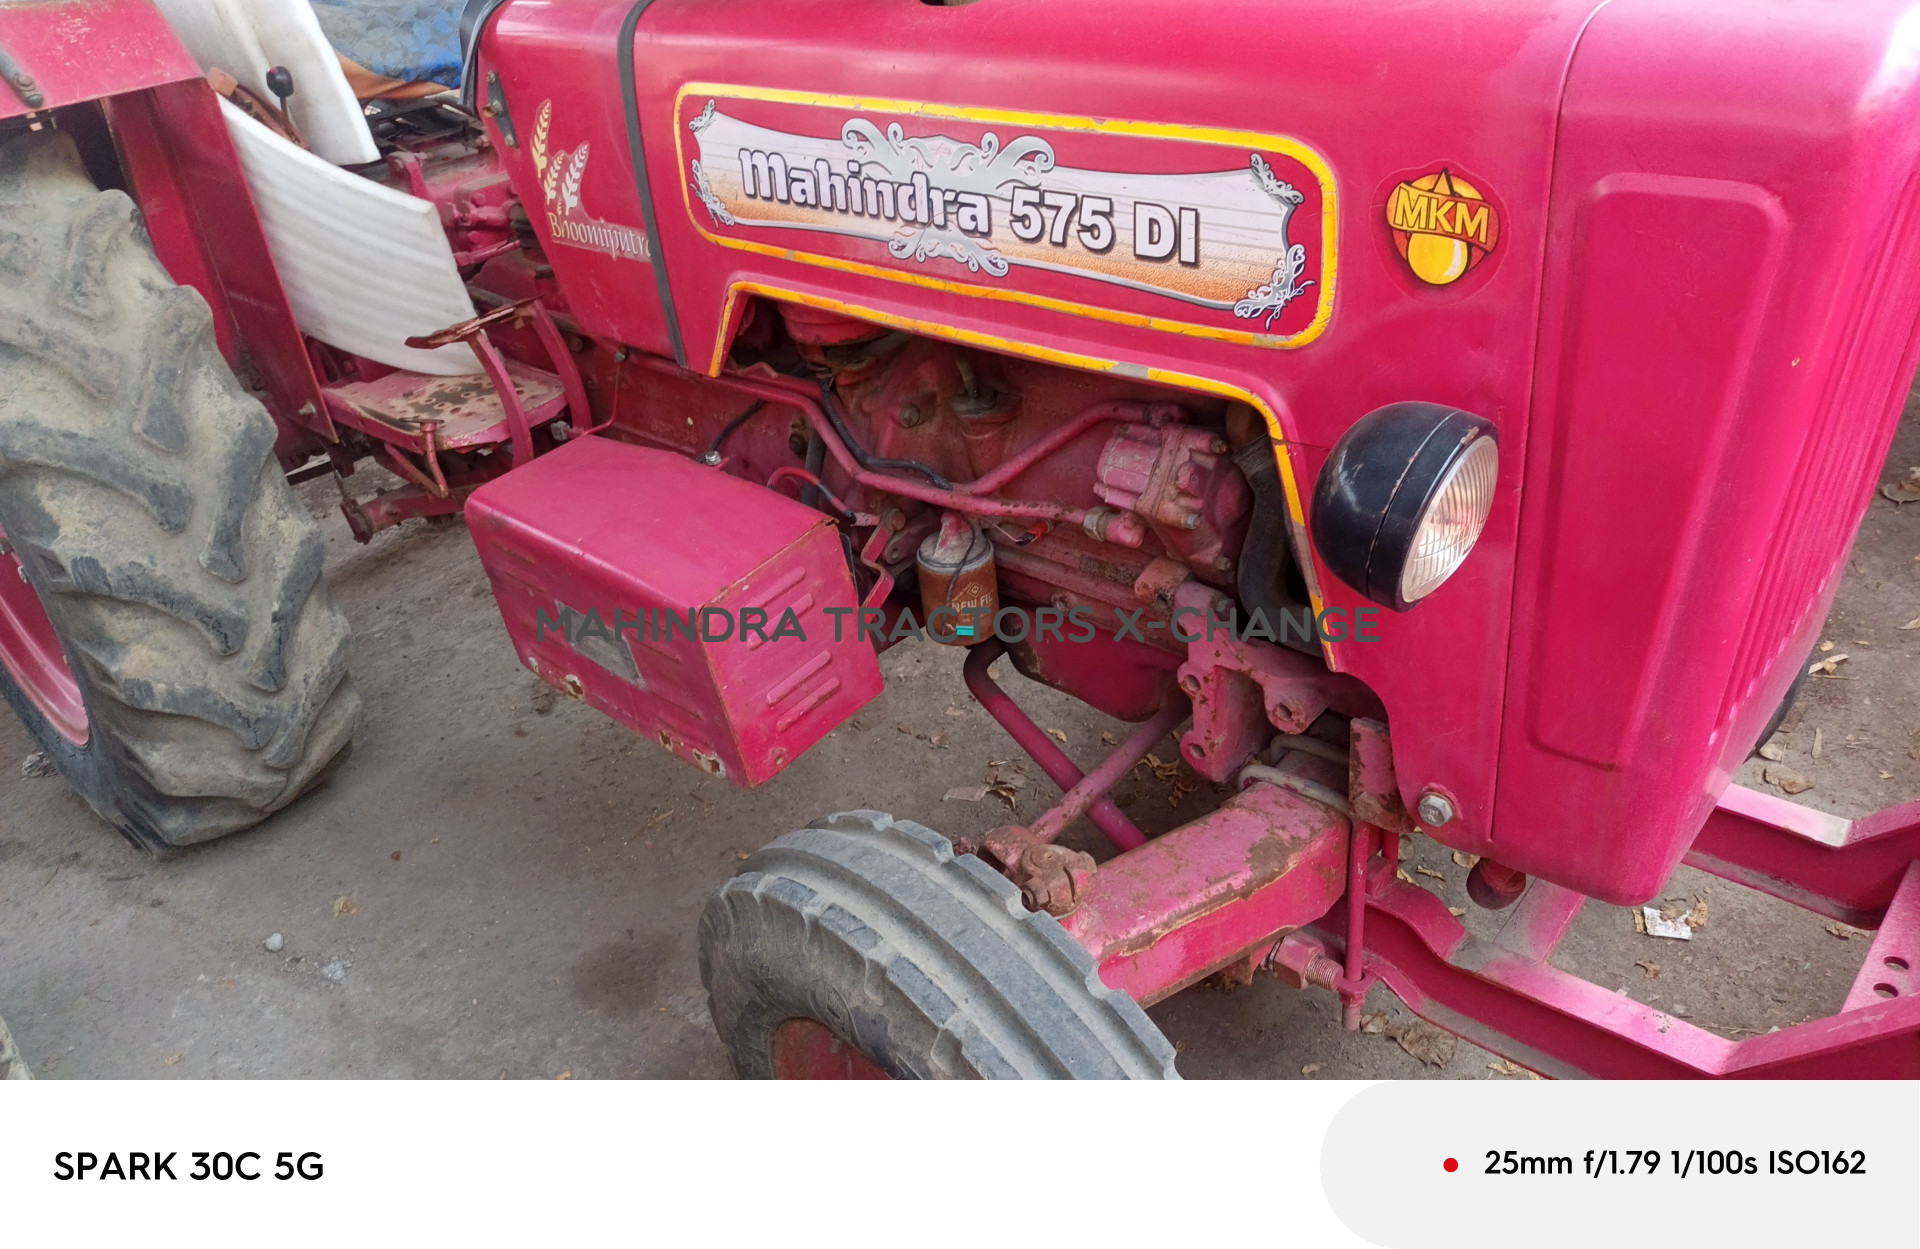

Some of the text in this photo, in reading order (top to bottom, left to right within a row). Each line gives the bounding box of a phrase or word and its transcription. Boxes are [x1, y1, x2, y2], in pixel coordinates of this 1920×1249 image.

[738, 148, 1201, 264] Mahindra 575 DI
[1393, 185, 1490, 245] MKM
